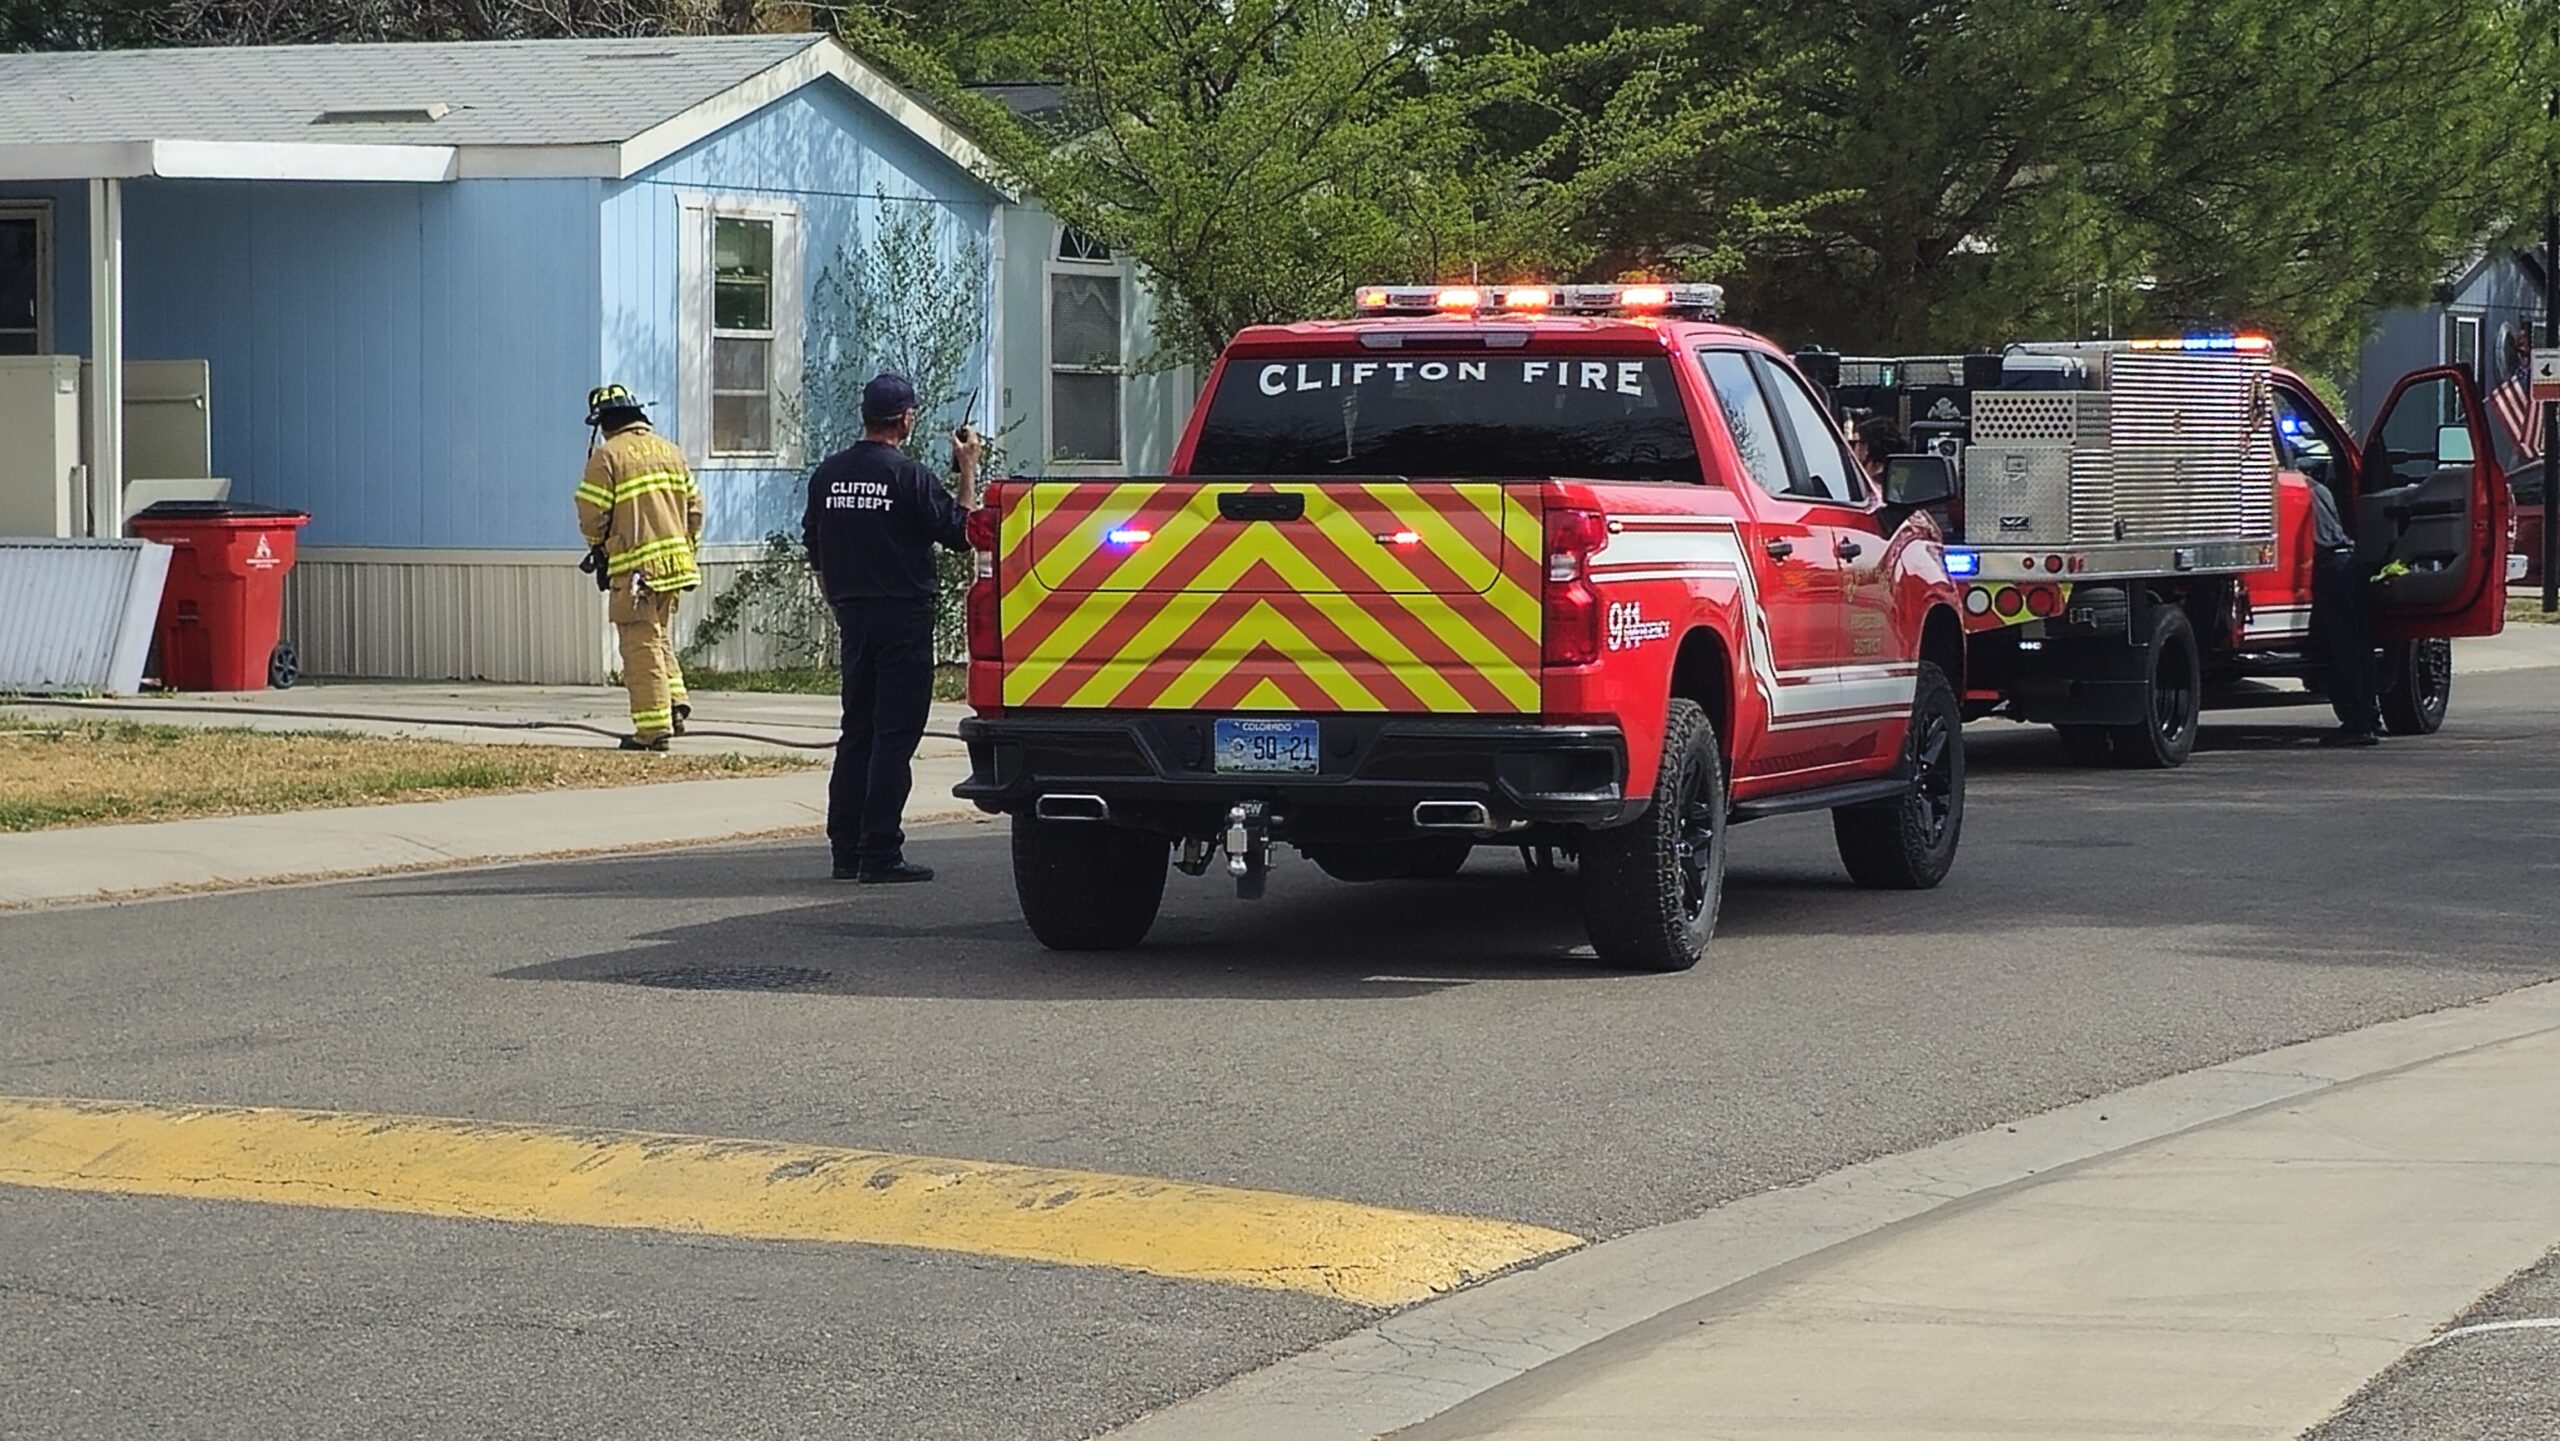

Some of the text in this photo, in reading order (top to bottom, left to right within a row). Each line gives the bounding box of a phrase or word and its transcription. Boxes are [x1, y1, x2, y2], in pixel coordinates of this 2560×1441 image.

[1258, 361, 1644, 397] CLIFTON FIRE
[830, 481, 889, 497] CLIFTON
[825, 496, 894, 512] FIRE DEPT
[1242, 722, 1292, 731] COLORADO
